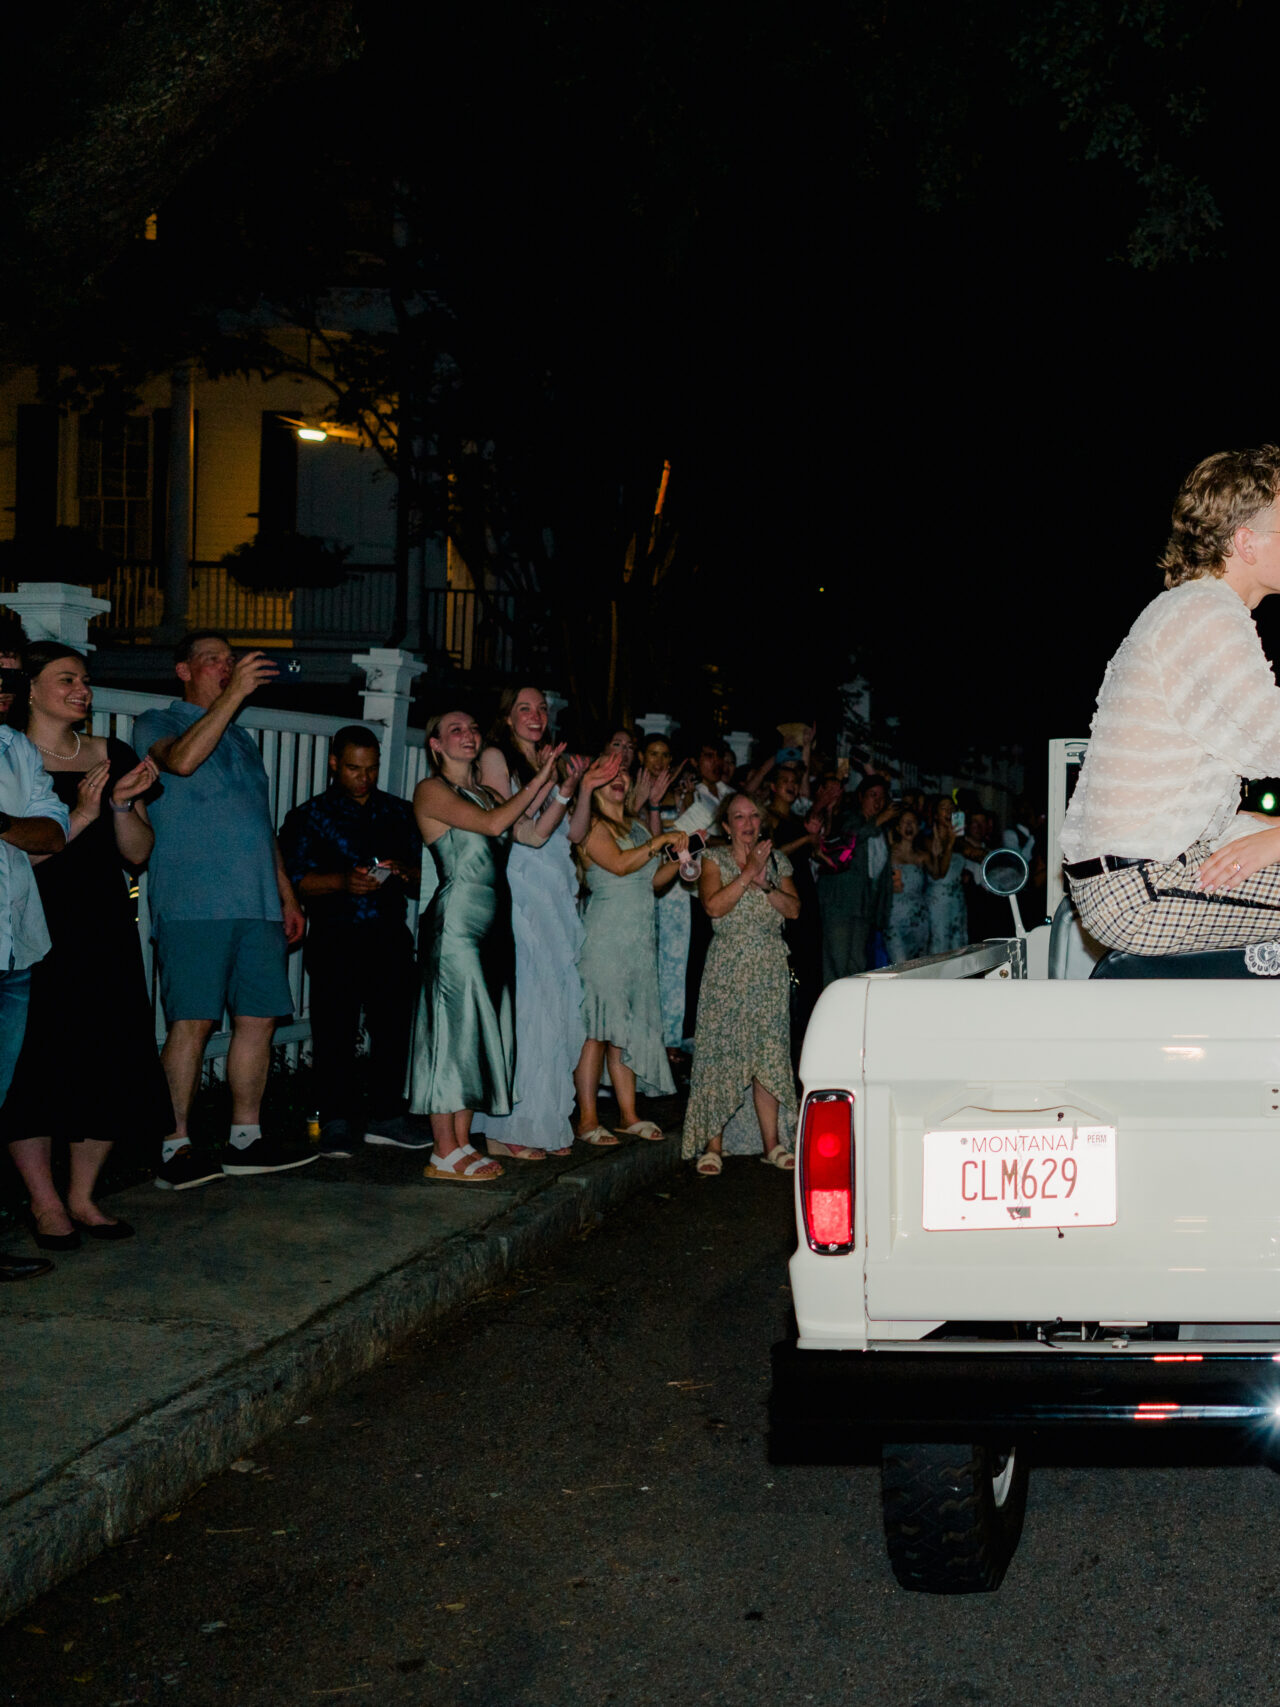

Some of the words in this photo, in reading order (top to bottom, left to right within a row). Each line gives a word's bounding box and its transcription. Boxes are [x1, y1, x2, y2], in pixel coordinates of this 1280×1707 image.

[971, 1134, 1068, 1153] MONTANA
[1087, 1134, 1107, 1144] PERM
[961, 1157, 1078, 1201] CLM629
